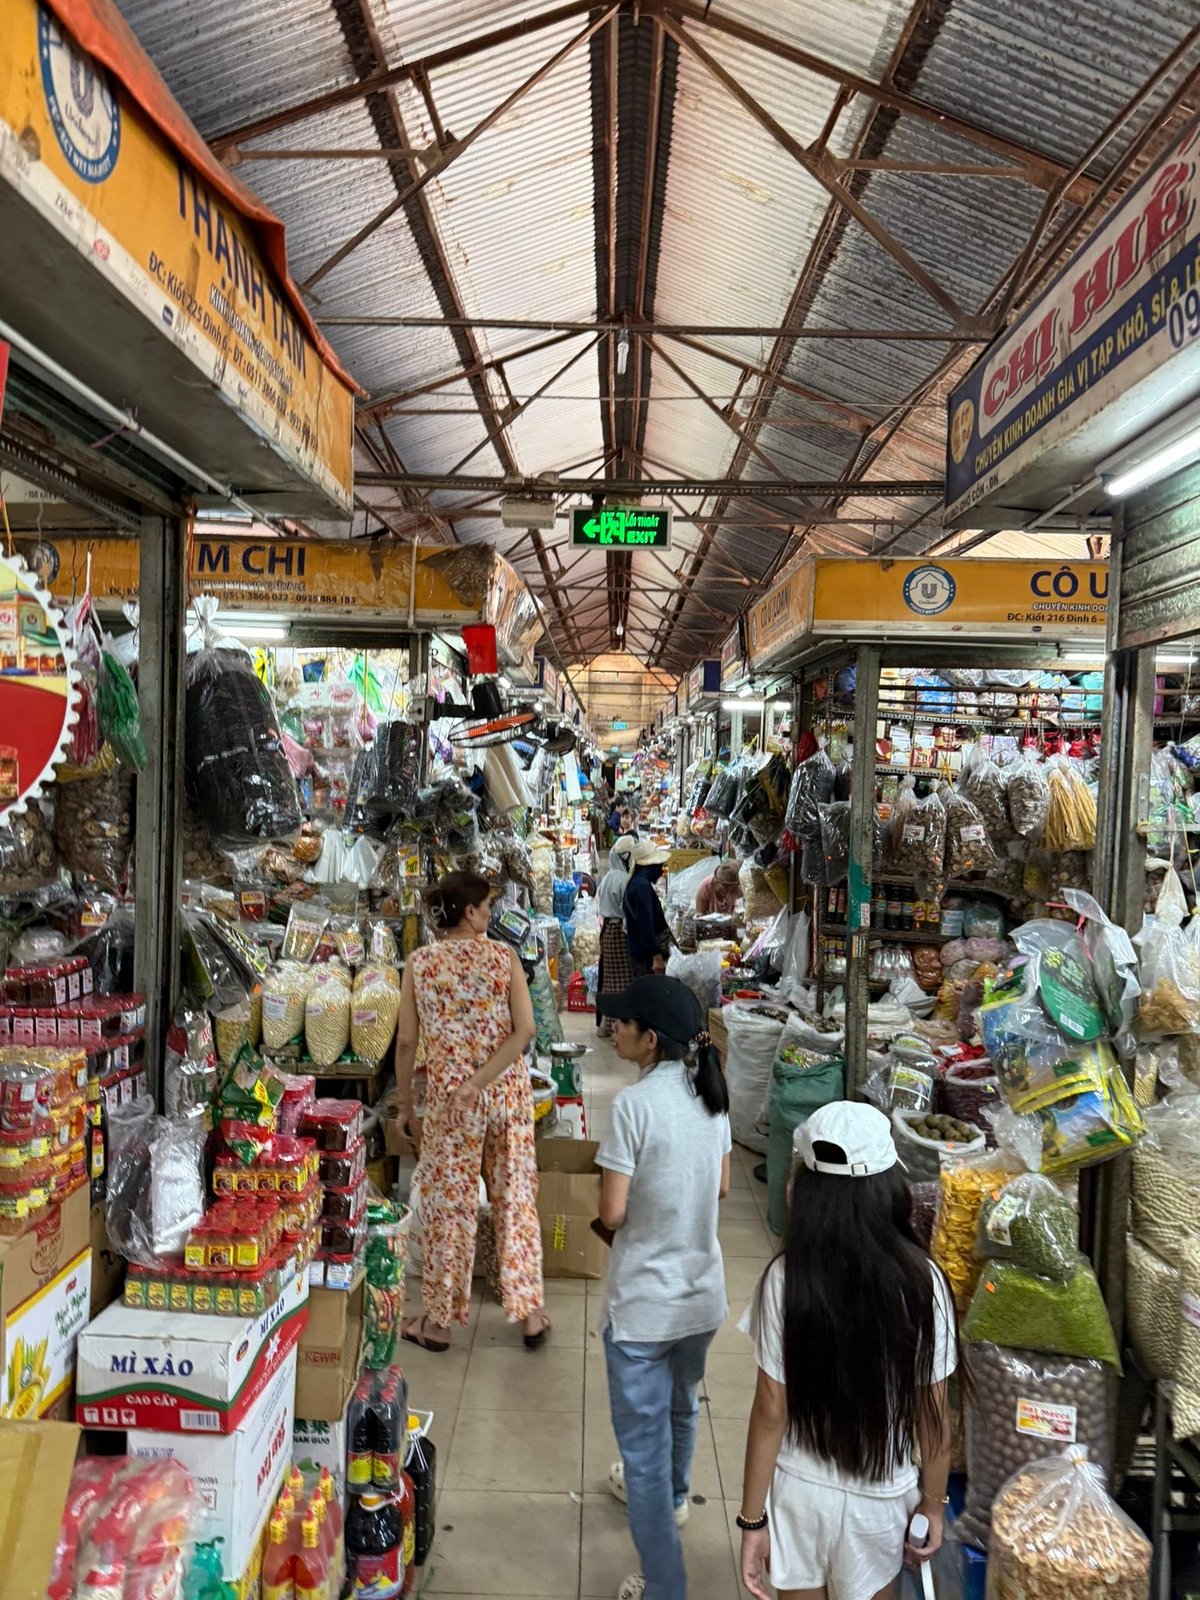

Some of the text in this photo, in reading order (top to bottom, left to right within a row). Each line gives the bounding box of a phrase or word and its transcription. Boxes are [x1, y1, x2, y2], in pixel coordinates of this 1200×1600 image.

[187, 294, 202, 323] 225
[983, 307, 1060, 418] CHỊ
[1004, 415, 1023, 451] KINH
[1025, 386, 1055, 433] DOANH
[1057, 371, 1075, 404] GIA
[1077, 356, 1088, 390] VỊ
[1091, 335, 1113, 377] TẠP
[1117, 302, 1148, 355] KHÔ,
[1169, 276, 1180, 303] &
[626, 531, 657, 544] EXIT
[241, 544, 306, 576] CHI
[1030, 565, 1079, 598] CÔ
[248, 592, 270, 601] 3866
[1032, 600, 1068, 612] CHUYÊN
[1069, 603, 1091, 612] KINH
[1007, 612, 1024, 621] ĐC:
[1026, 611, 1045, 621] Kiốt
[1047, 613, 1065, 622] 216
[1091, 614, 1098, 623] 6
[110, 1351, 194, 1377] MÌ XÀO
[125, 1394, 151, 1406] CAO
